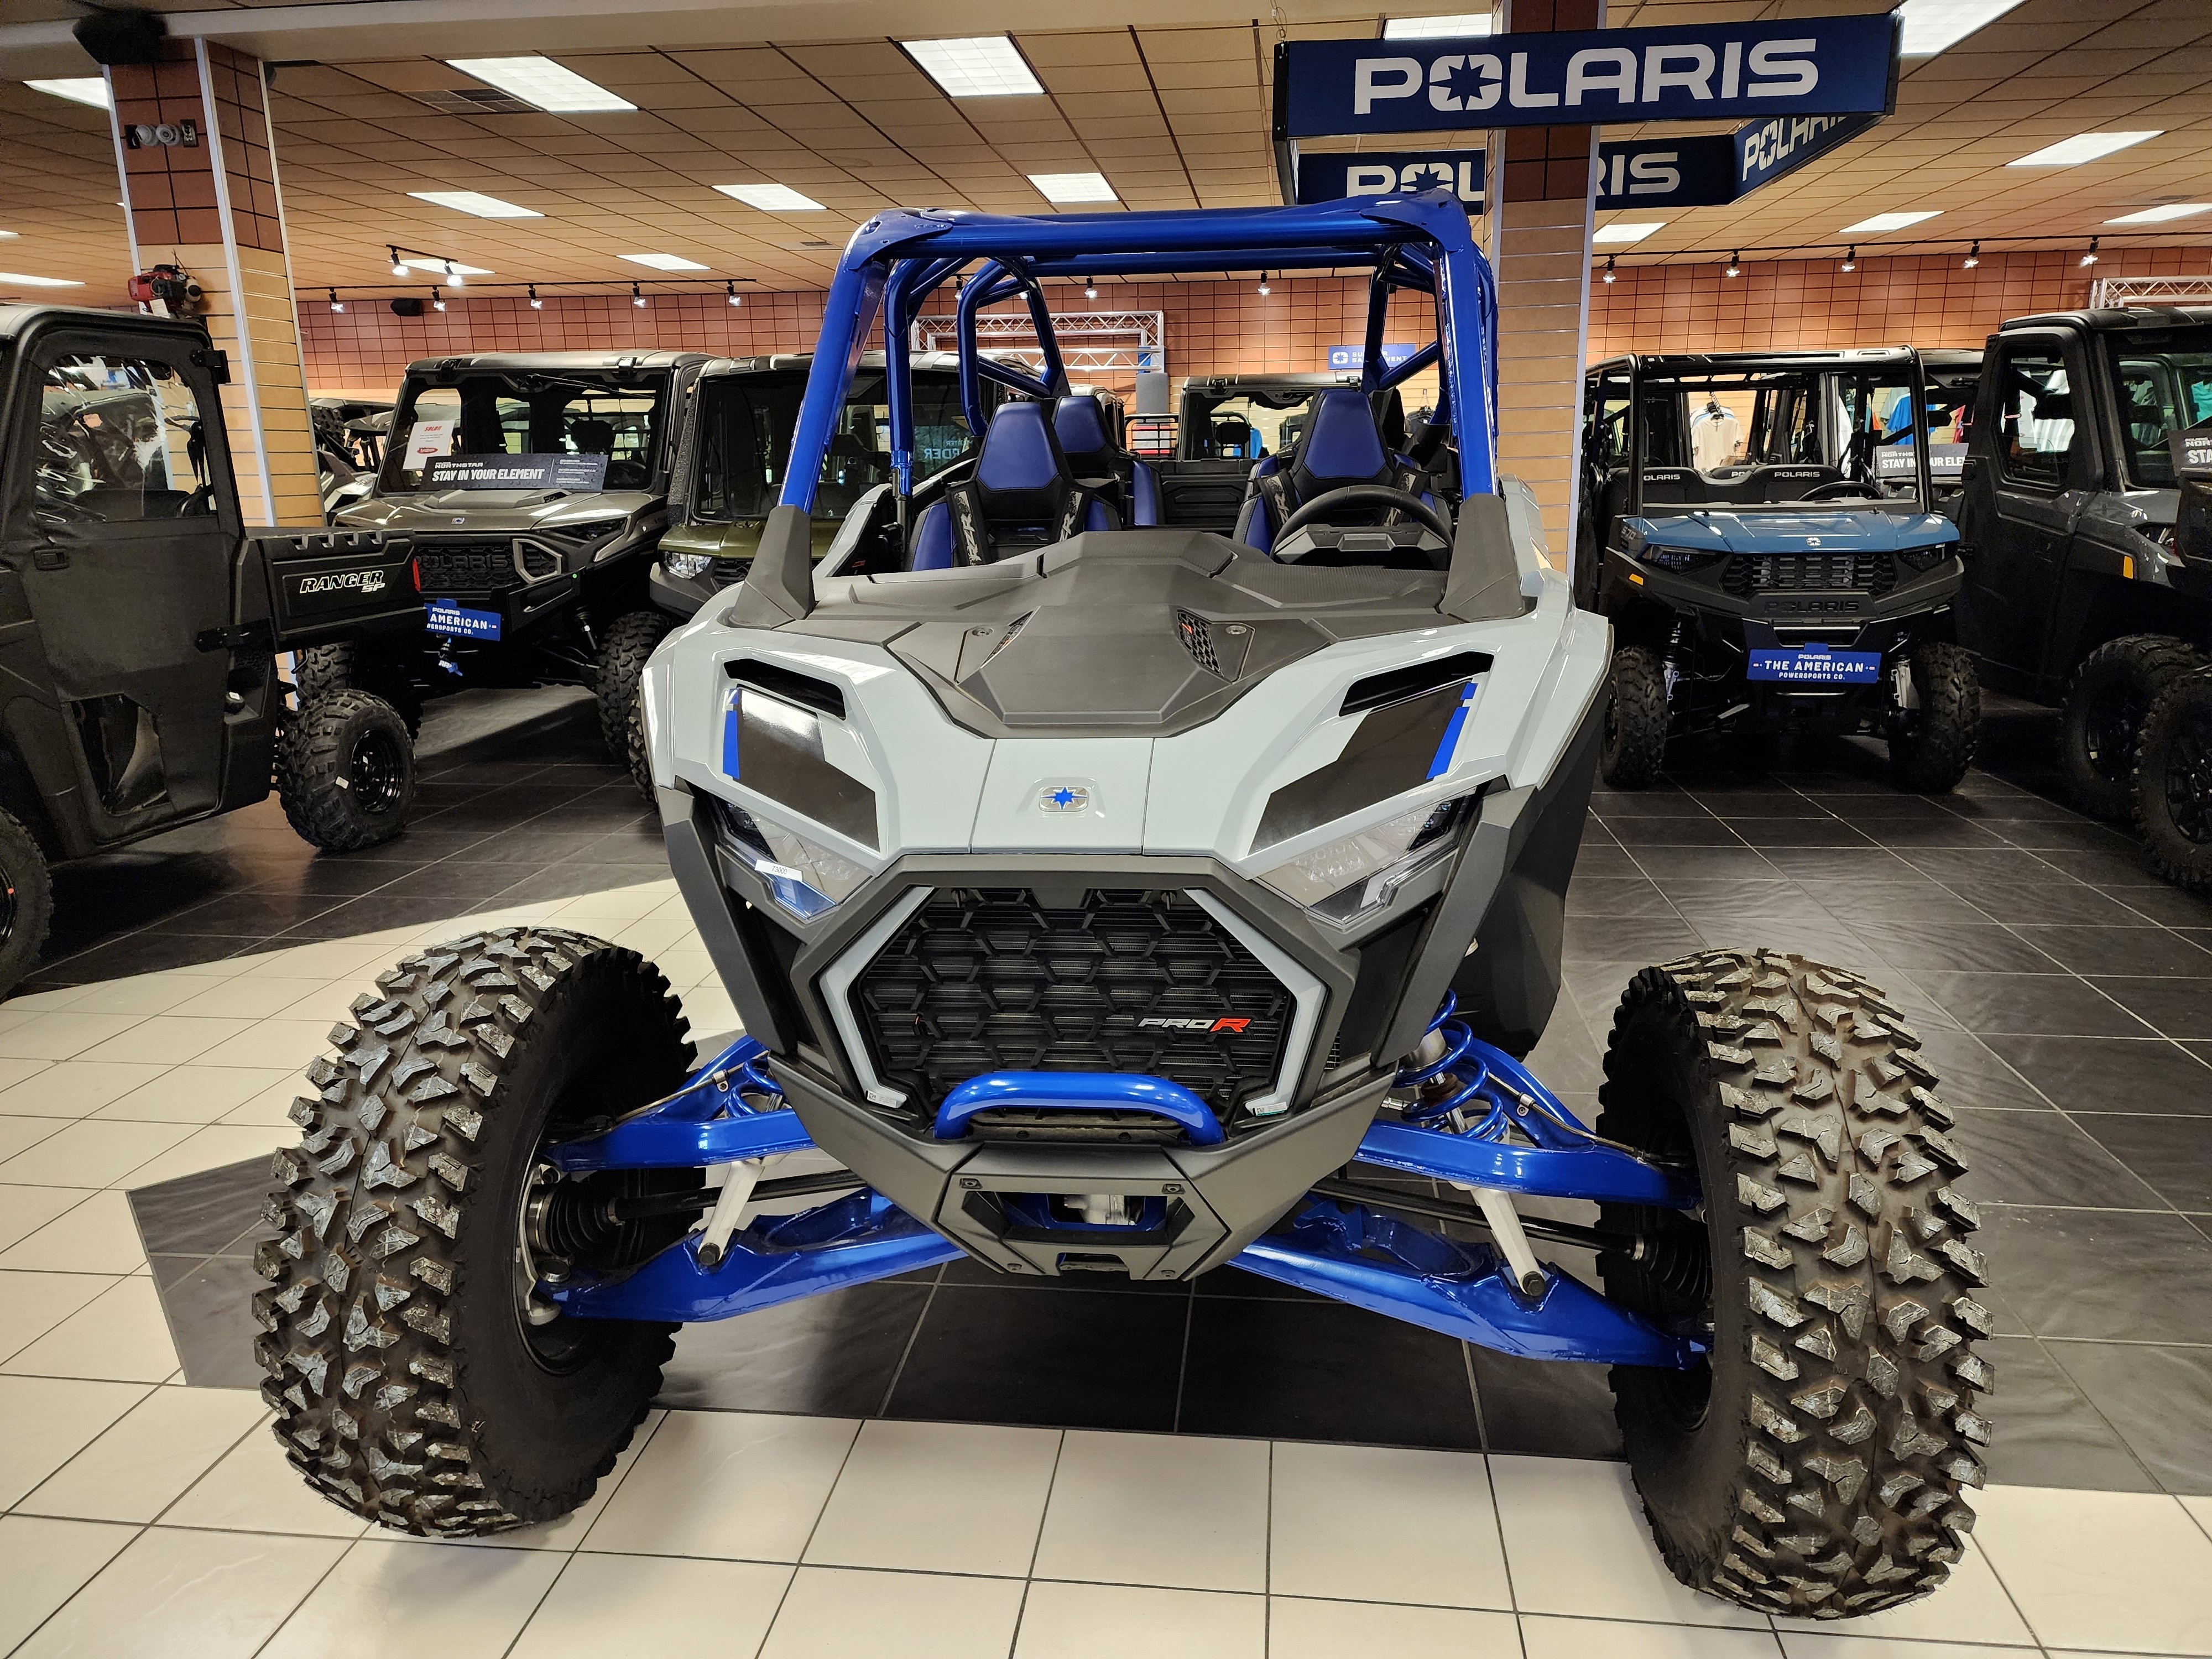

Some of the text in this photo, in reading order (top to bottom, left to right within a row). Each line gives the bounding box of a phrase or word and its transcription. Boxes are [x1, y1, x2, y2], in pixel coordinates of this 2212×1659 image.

[1354, 38, 1818, 114] POLARIS
[1742, 117, 1847, 182] POLA
[1882, 458, 1906, 469] STAY
[1907, 457, 1916, 468] IN
[432, 469, 456, 482] STAY
[457, 469, 469, 481] IN
[471, 469, 495, 480] YOUR
[497, 468, 545, 479] ELEMENT
[299, 570, 384, 593] RANGER
[361, 582, 385, 593] SP
[432, 607, 460, 615] POLARIS
[1765, 601, 1860, 613] POLARIS
[426, 623, 462, 633] WERSPORTS
[430, 613, 487, 630] AMERICAN
[1765, 660, 1864, 672] THE AMERICAN
[1138, 1018, 1251, 1032] PRO R
